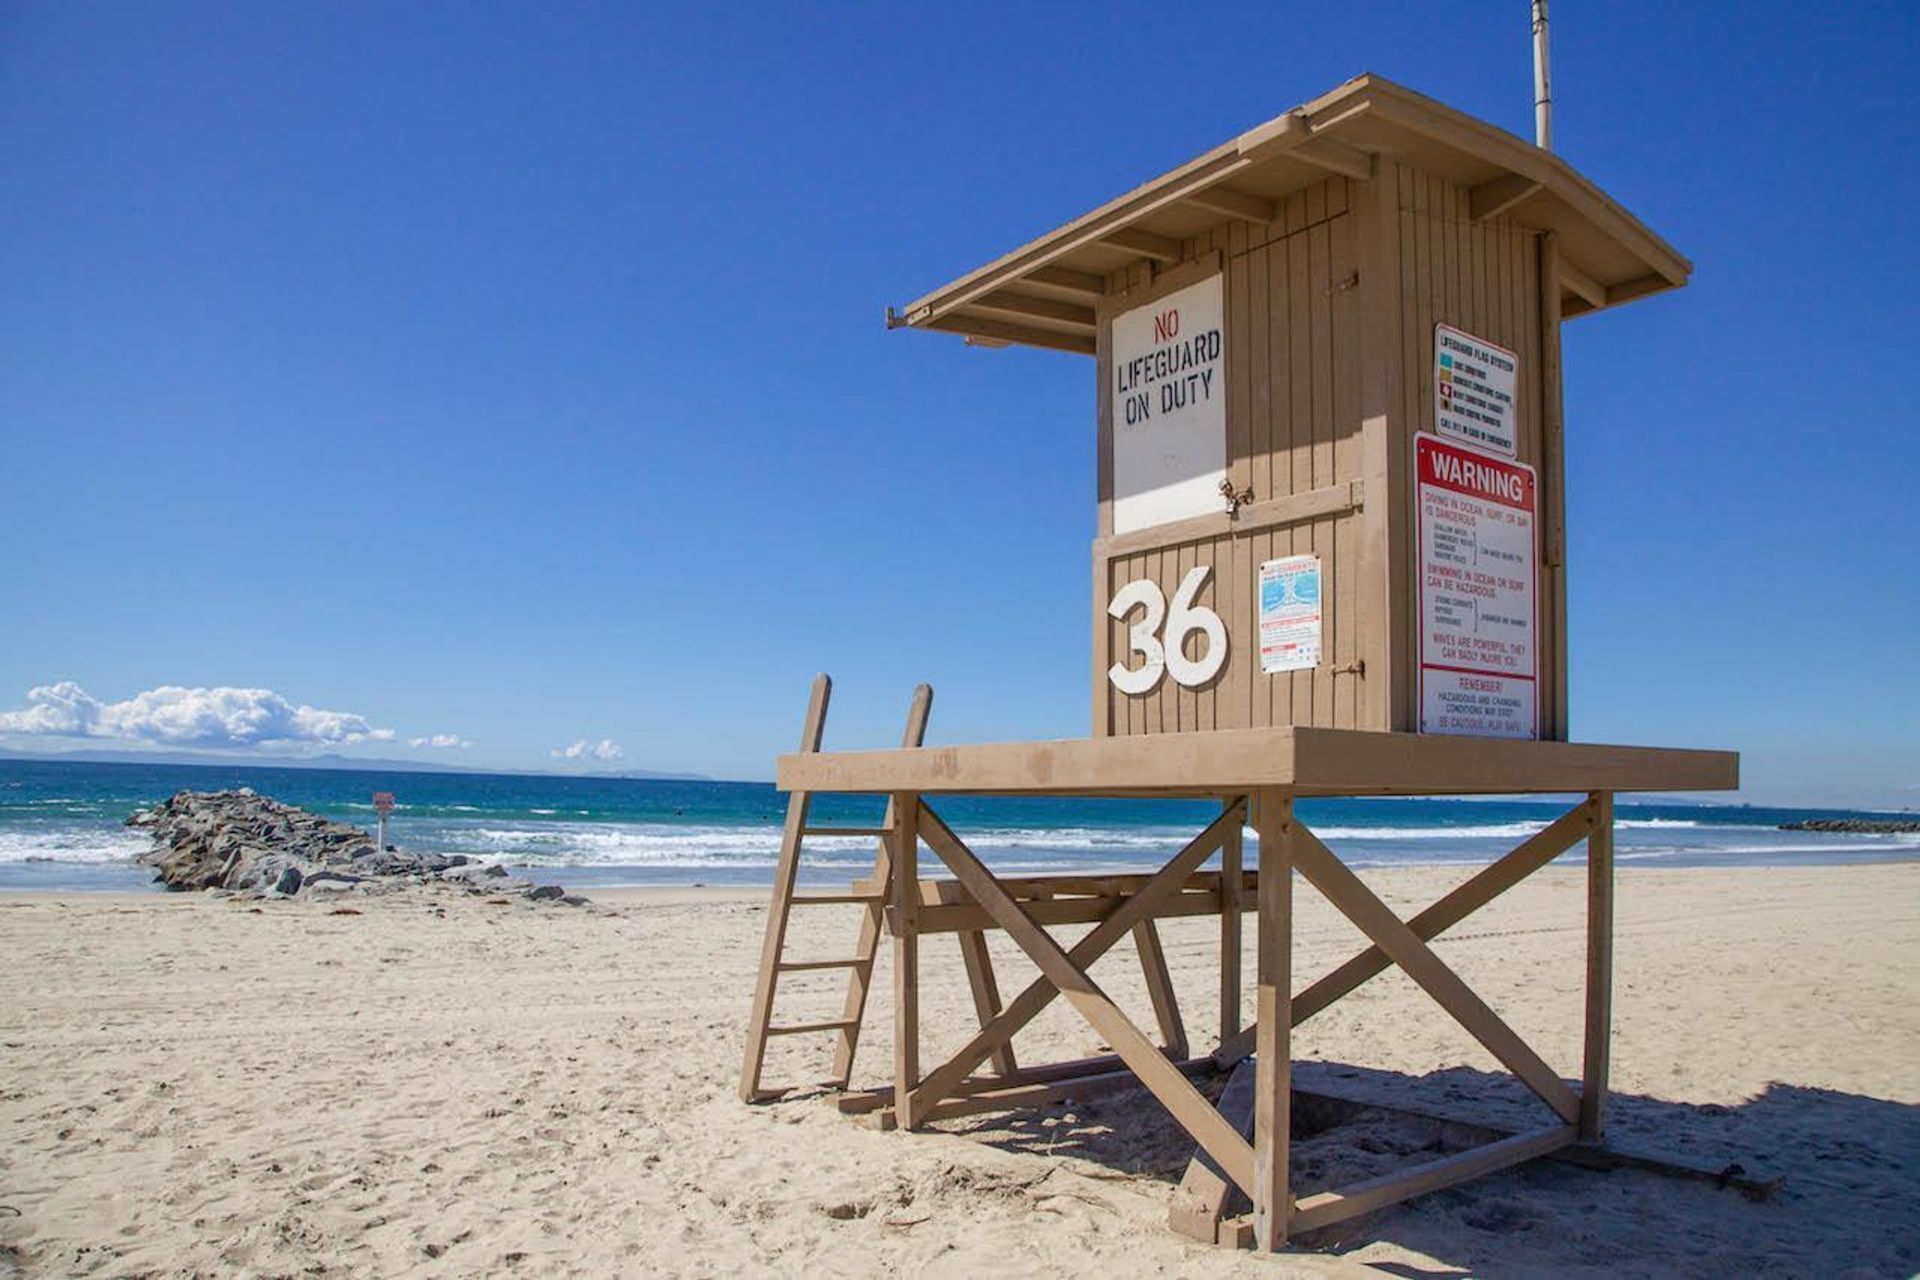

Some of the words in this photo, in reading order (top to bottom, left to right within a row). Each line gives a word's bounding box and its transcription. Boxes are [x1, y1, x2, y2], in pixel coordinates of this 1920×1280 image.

[1154, 309, 1179, 345] NO
[1440, 335, 1473, 357] LIFEGUARD
[1474, 348, 1489, 363] FLAG
[1118, 330, 1221, 395] LIFEGUARD
[1126, 391, 1150, 426] ON
[1161, 367, 1213, 415] DUTY
[1431, 450, 1523, 503] WARNING
[1107, 565, 1227, 694] 36
